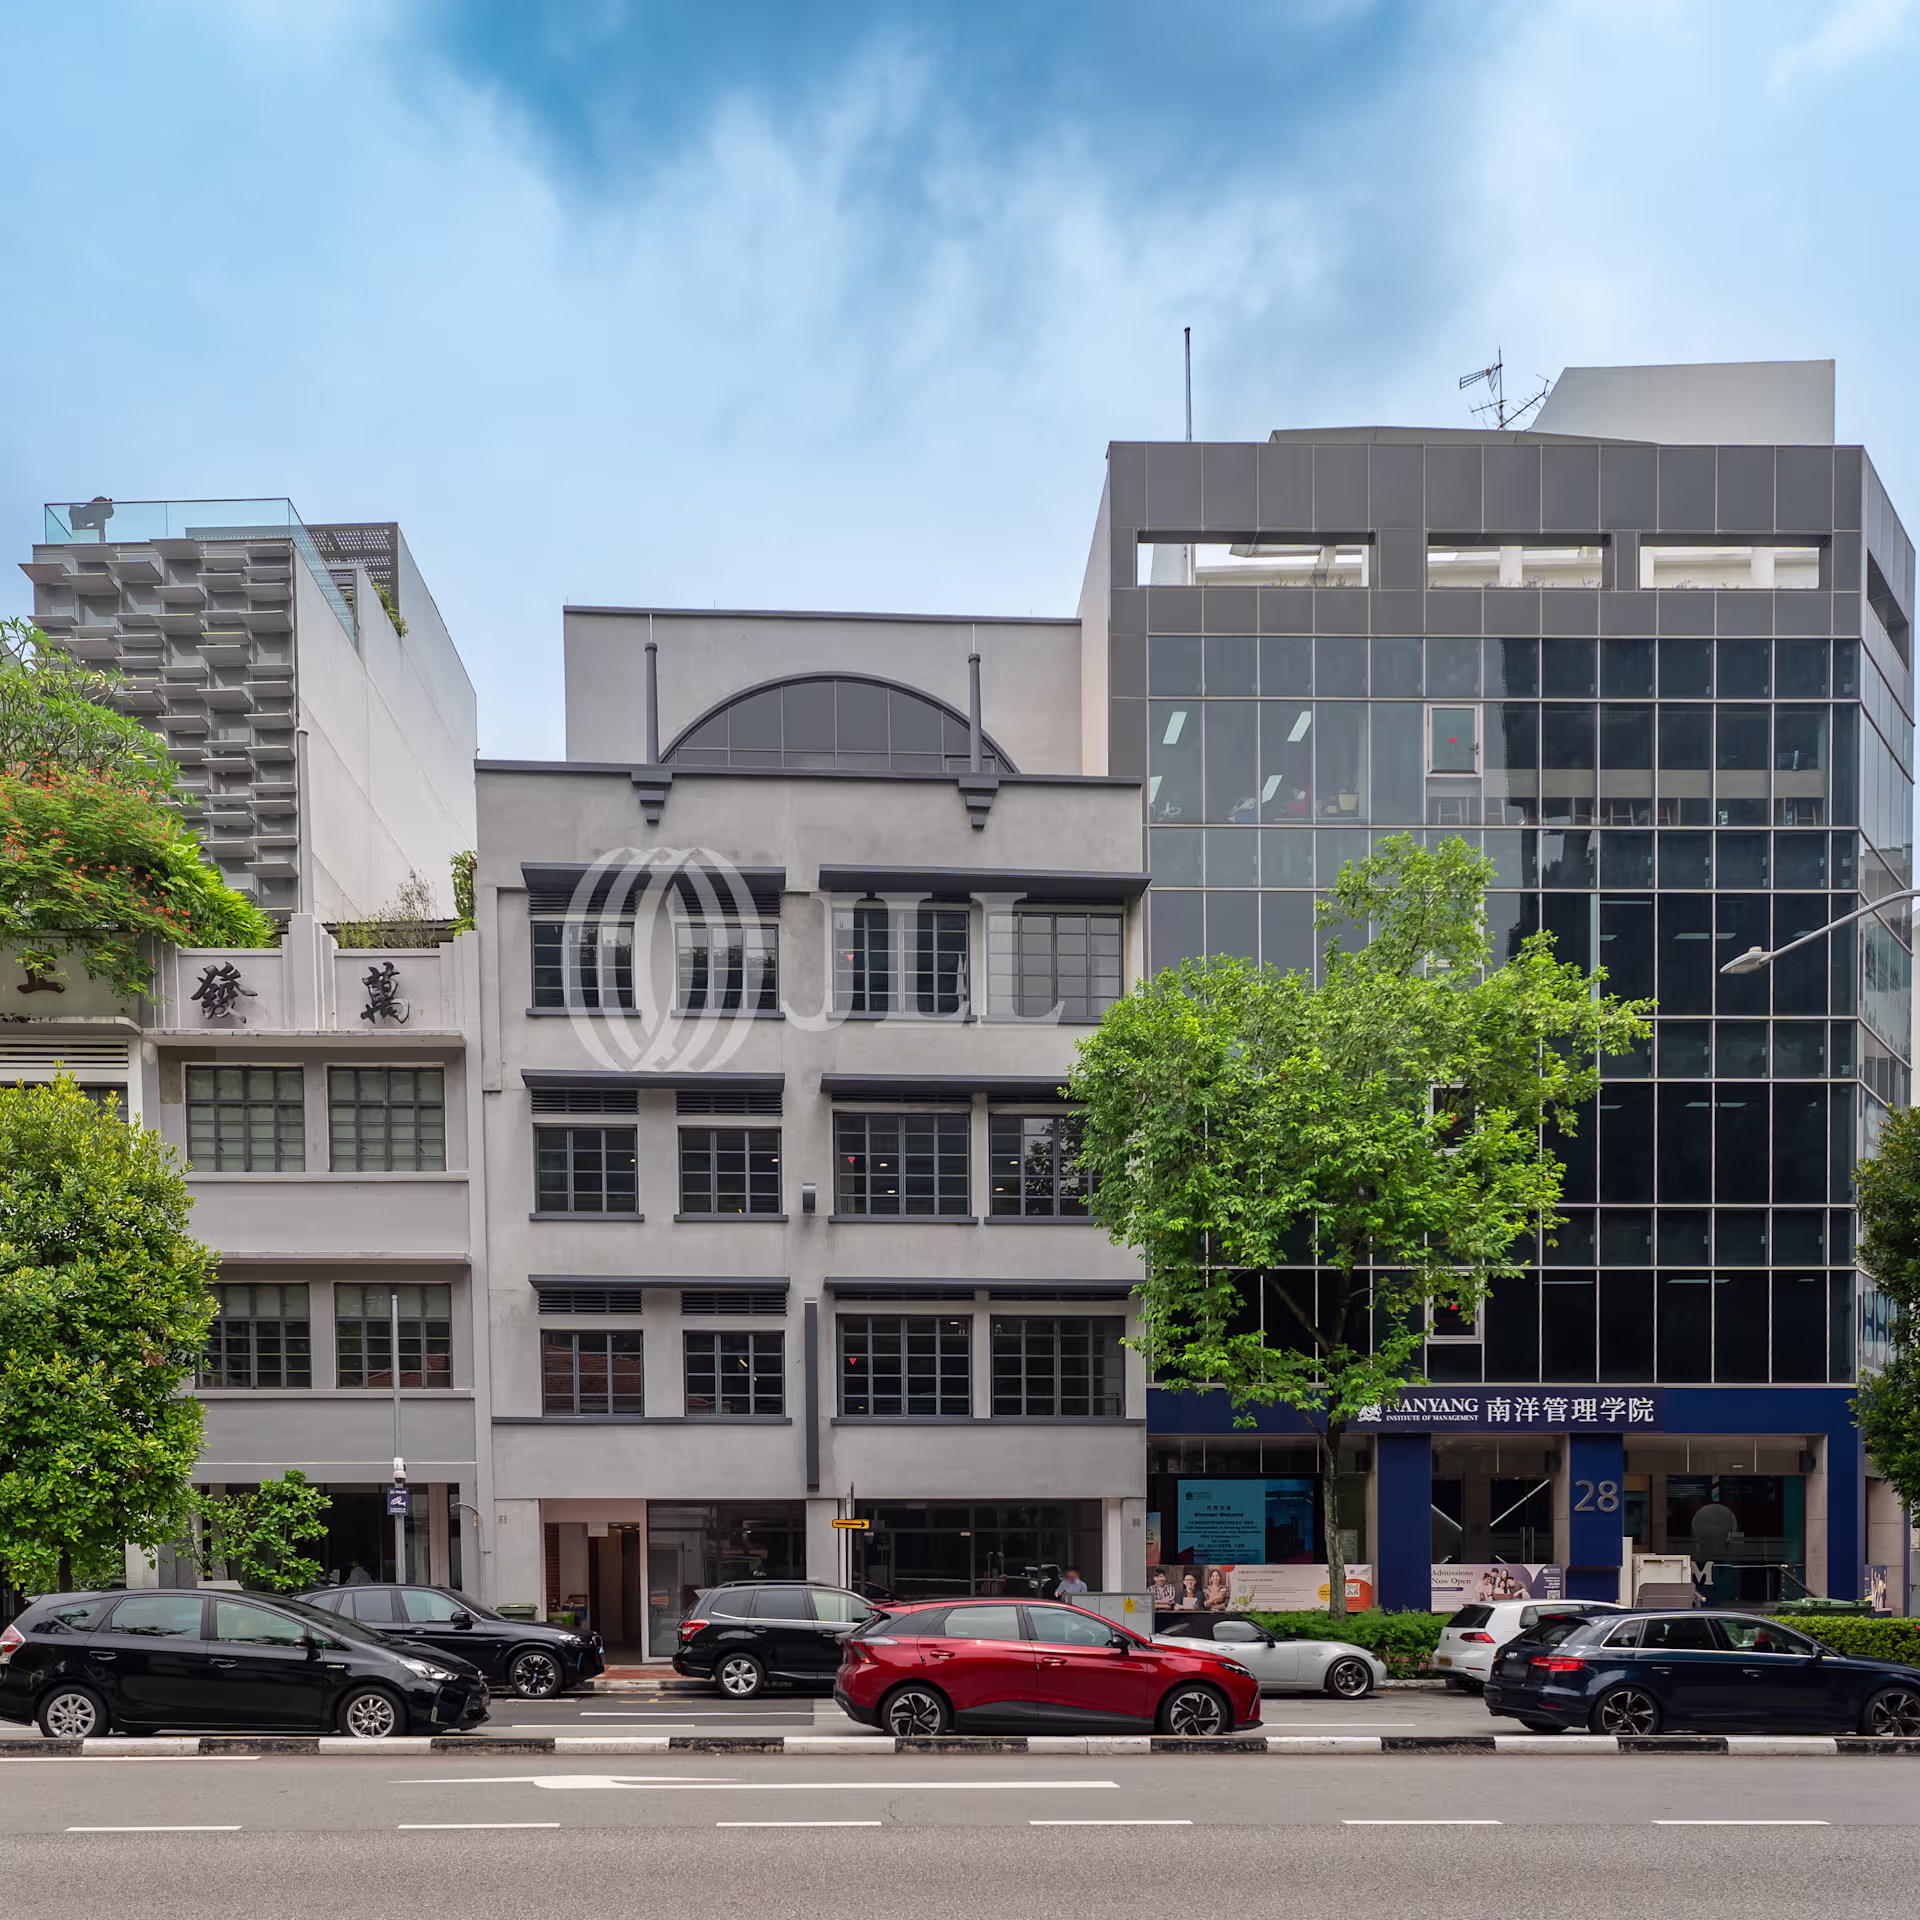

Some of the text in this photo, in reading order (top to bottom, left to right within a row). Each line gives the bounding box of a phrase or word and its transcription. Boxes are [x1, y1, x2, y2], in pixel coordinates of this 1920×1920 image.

[1485, 1396, 1655, 1423] 南洋管理学院
[1574, 1480, 1619, 1512] 28
[1451, 1577, 1471, 1586] Open
[1691, 1561, 1714, 1585] M
